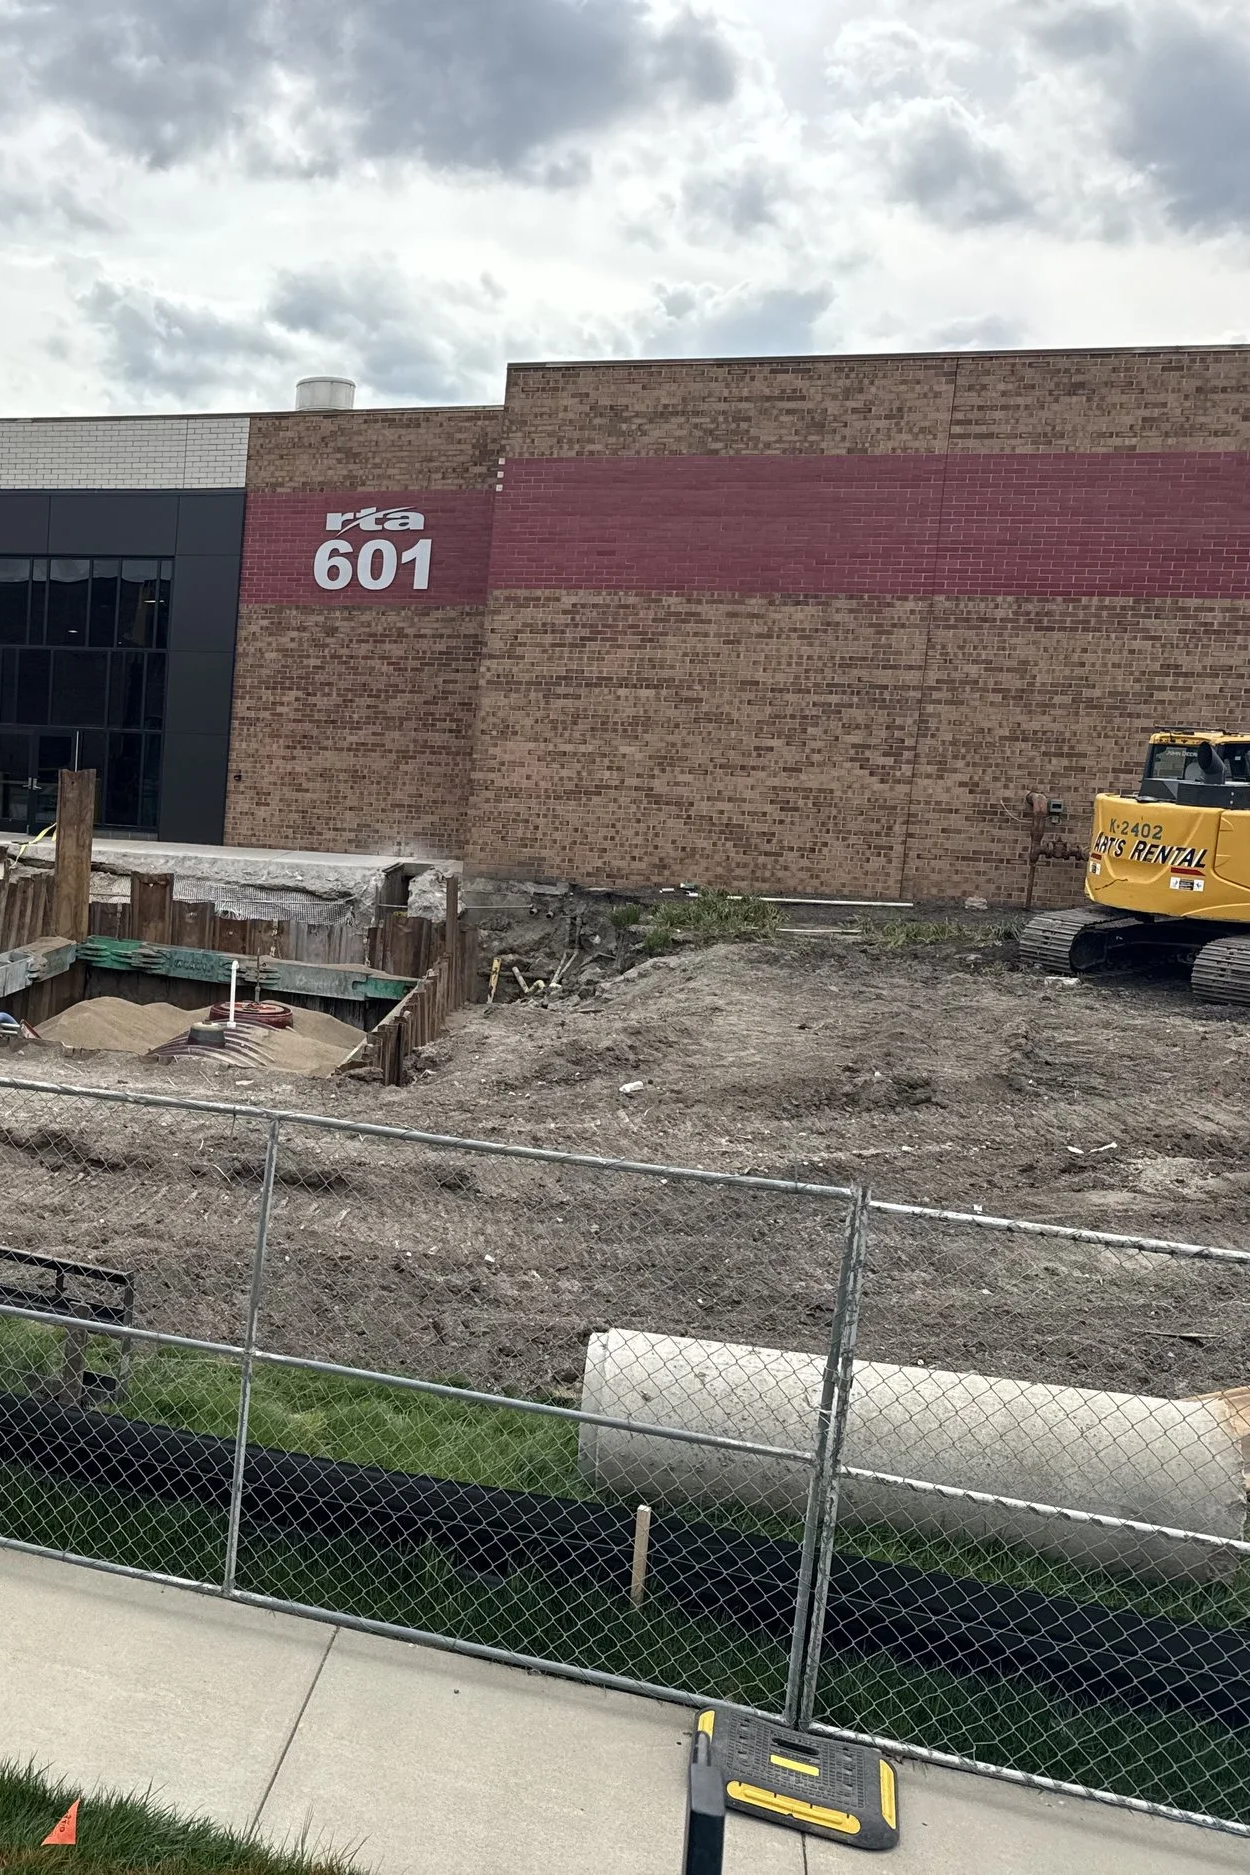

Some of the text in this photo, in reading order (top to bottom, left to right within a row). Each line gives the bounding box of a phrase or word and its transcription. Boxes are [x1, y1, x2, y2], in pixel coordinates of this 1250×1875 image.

[325, 506, 425, 536] rta
[313, 538, 433, 590] 601
[1093, 831, 1209, 868] ART'S RENTAL
